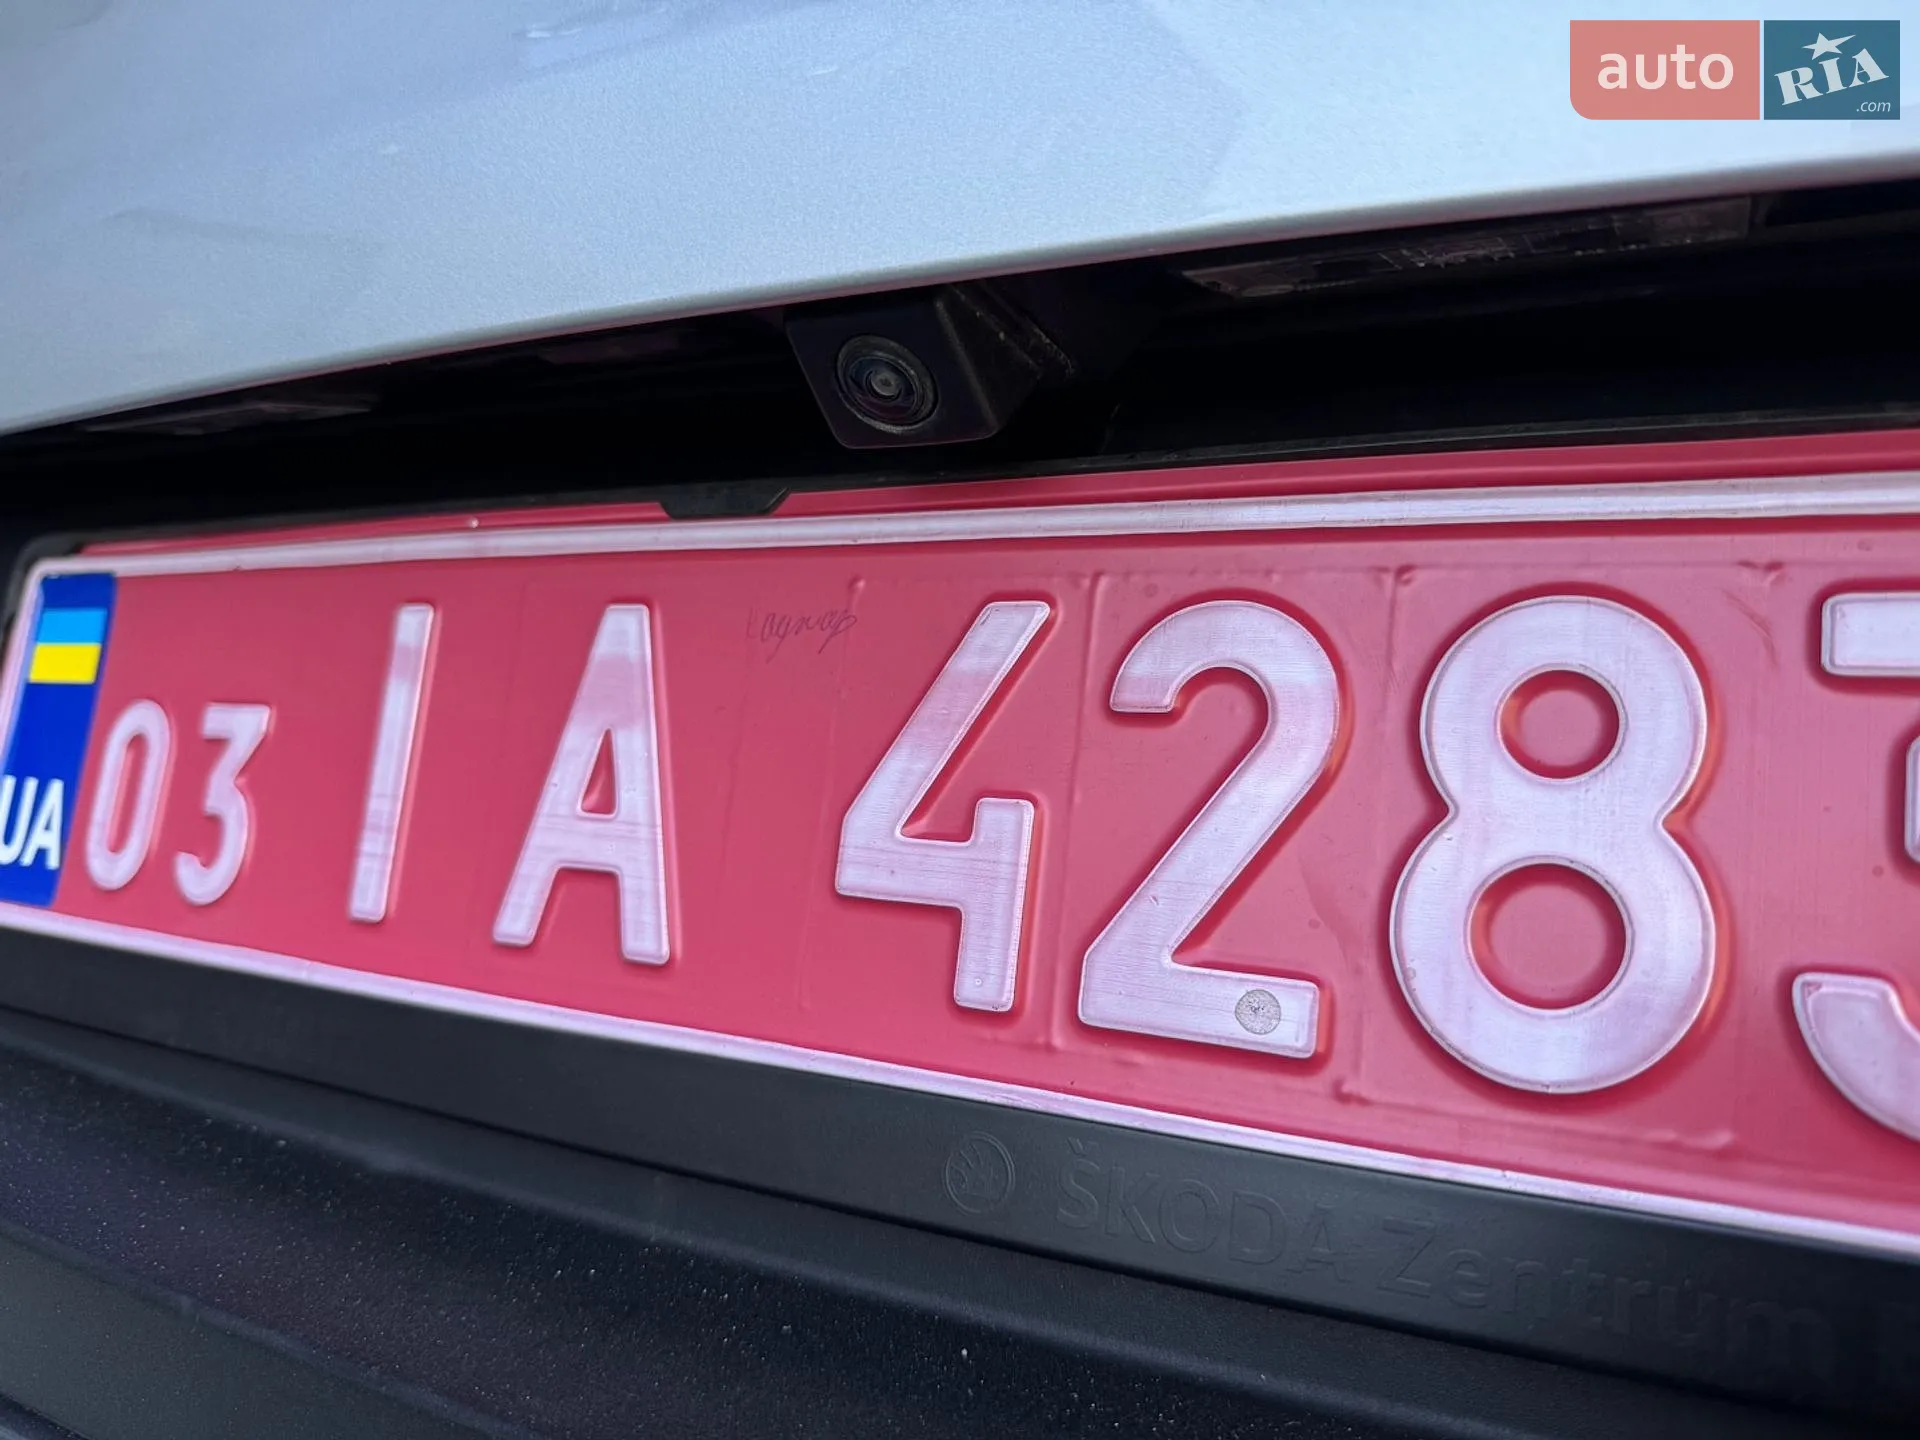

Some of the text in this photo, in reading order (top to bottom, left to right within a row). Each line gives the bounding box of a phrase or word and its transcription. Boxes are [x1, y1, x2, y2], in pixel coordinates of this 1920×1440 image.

[0, 773, 65, 870] UA
[85, 699, 272, 906] 03
[1054, 1136, 1352, 1284] ŠKODA
[1376, 1216, 1836, 1390] Zentrum
